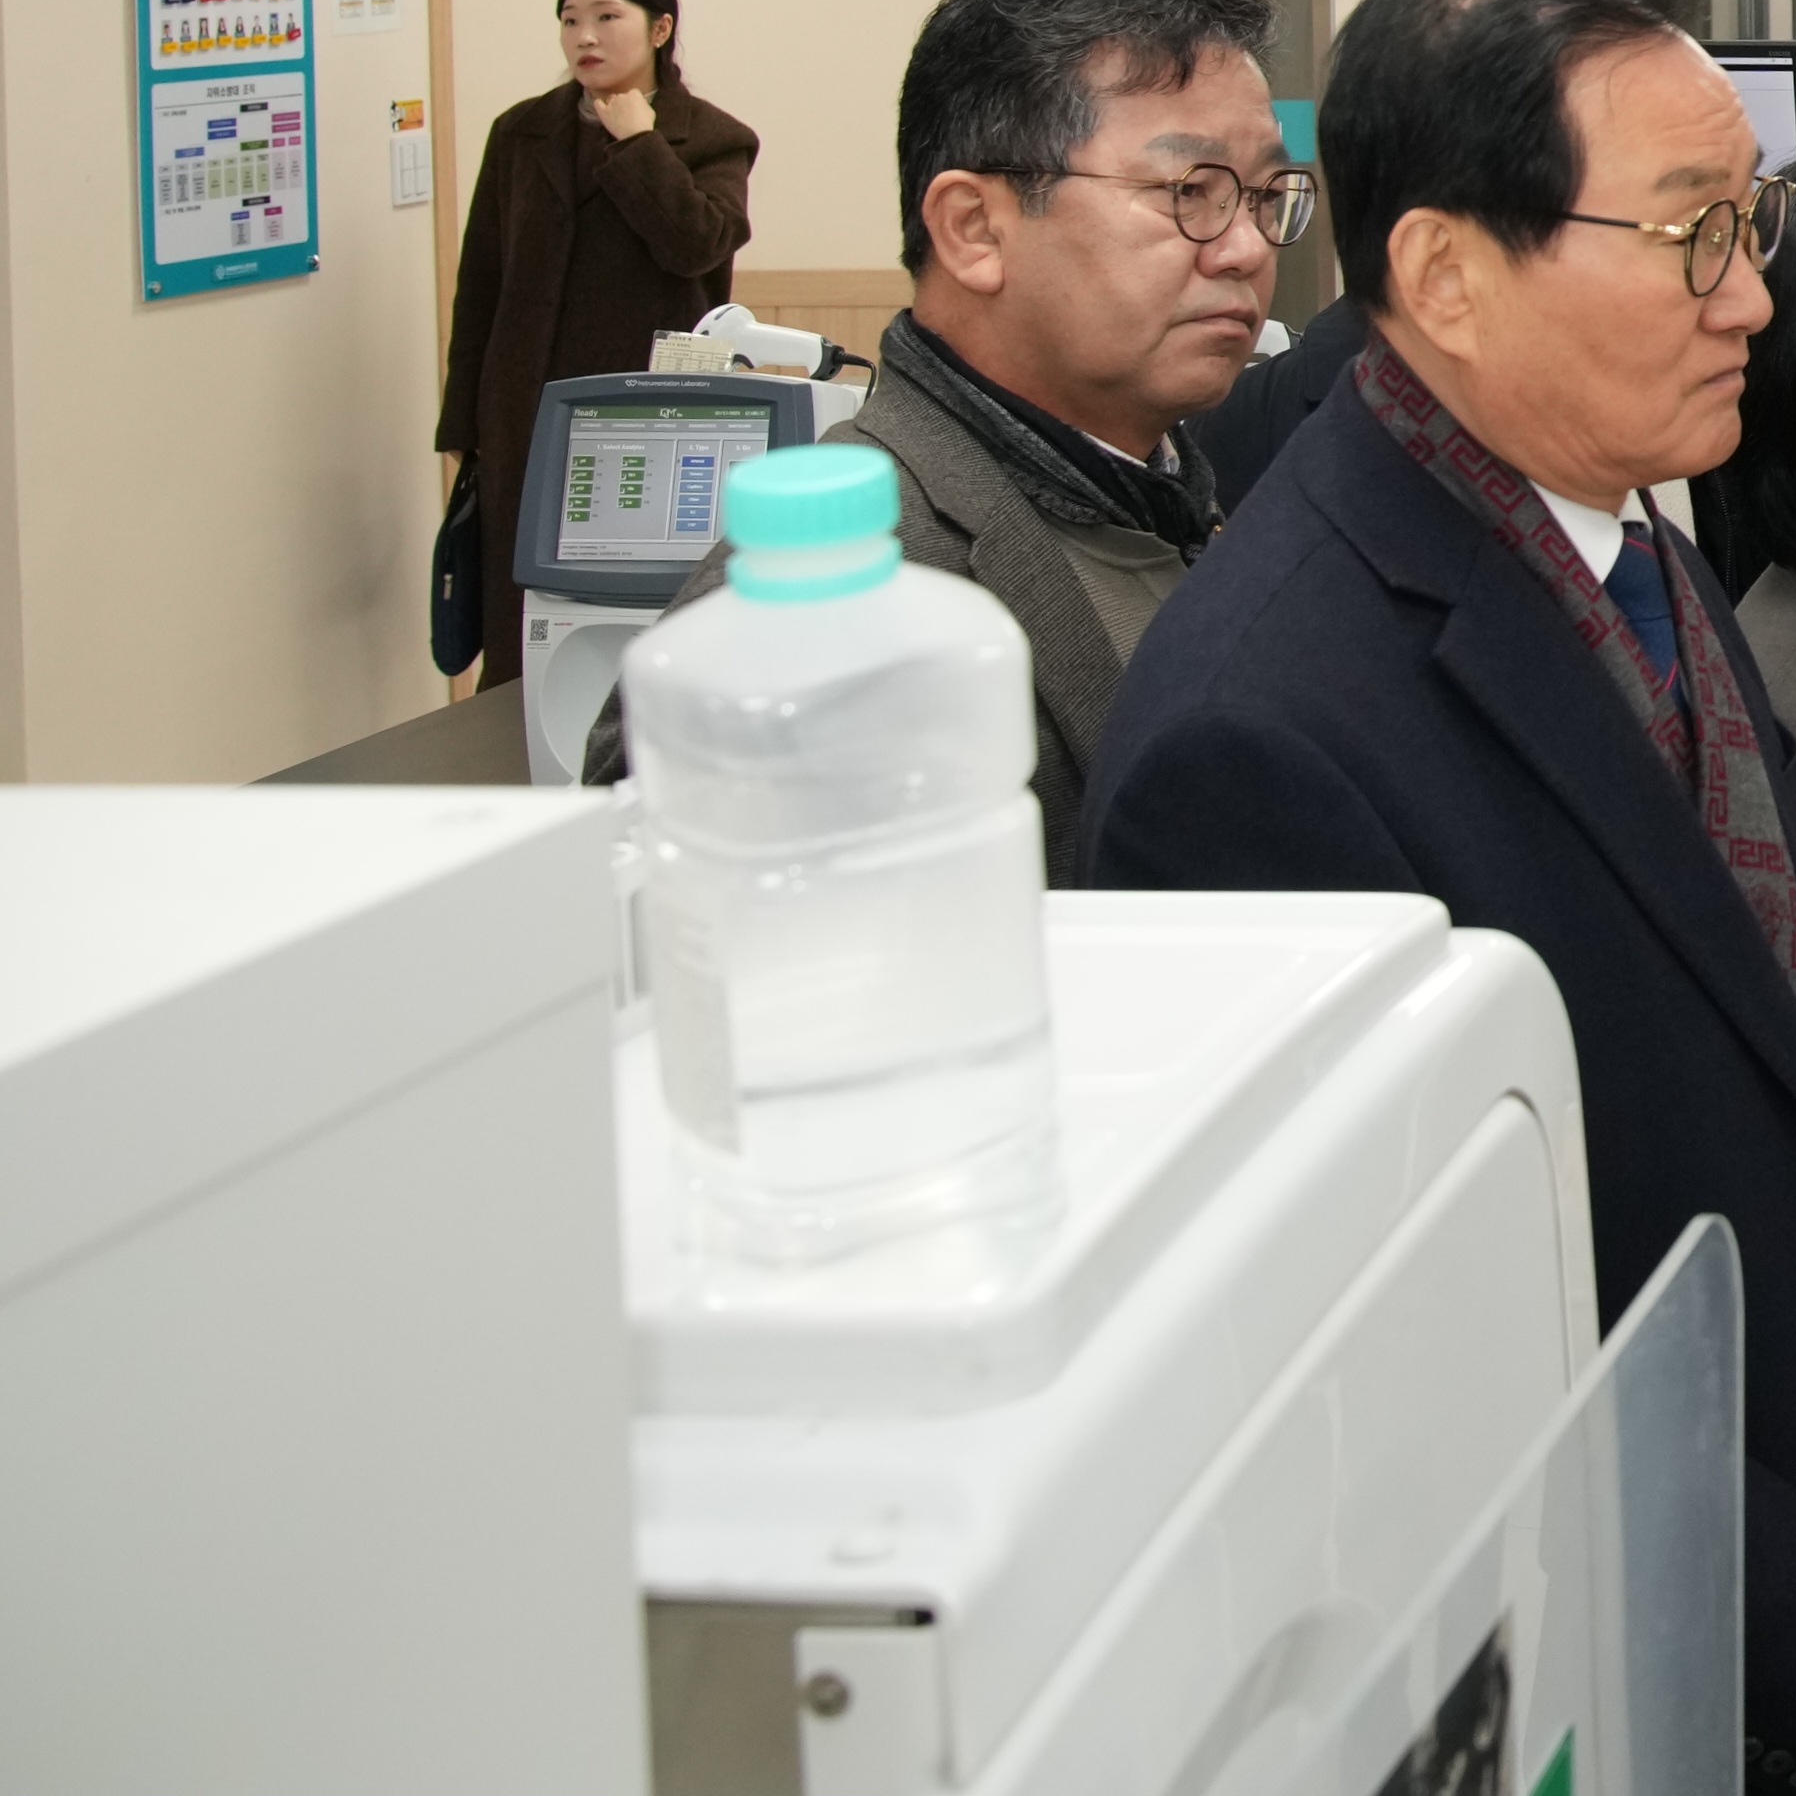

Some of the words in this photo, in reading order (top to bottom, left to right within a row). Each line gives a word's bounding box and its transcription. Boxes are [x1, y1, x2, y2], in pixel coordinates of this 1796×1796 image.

[637, 379, 680, 388] Instrumentation
[681, 380, 711, 389] Laboratory
[573, 408, 599, 418] Ready
[695, 444, 709, 452] Type
